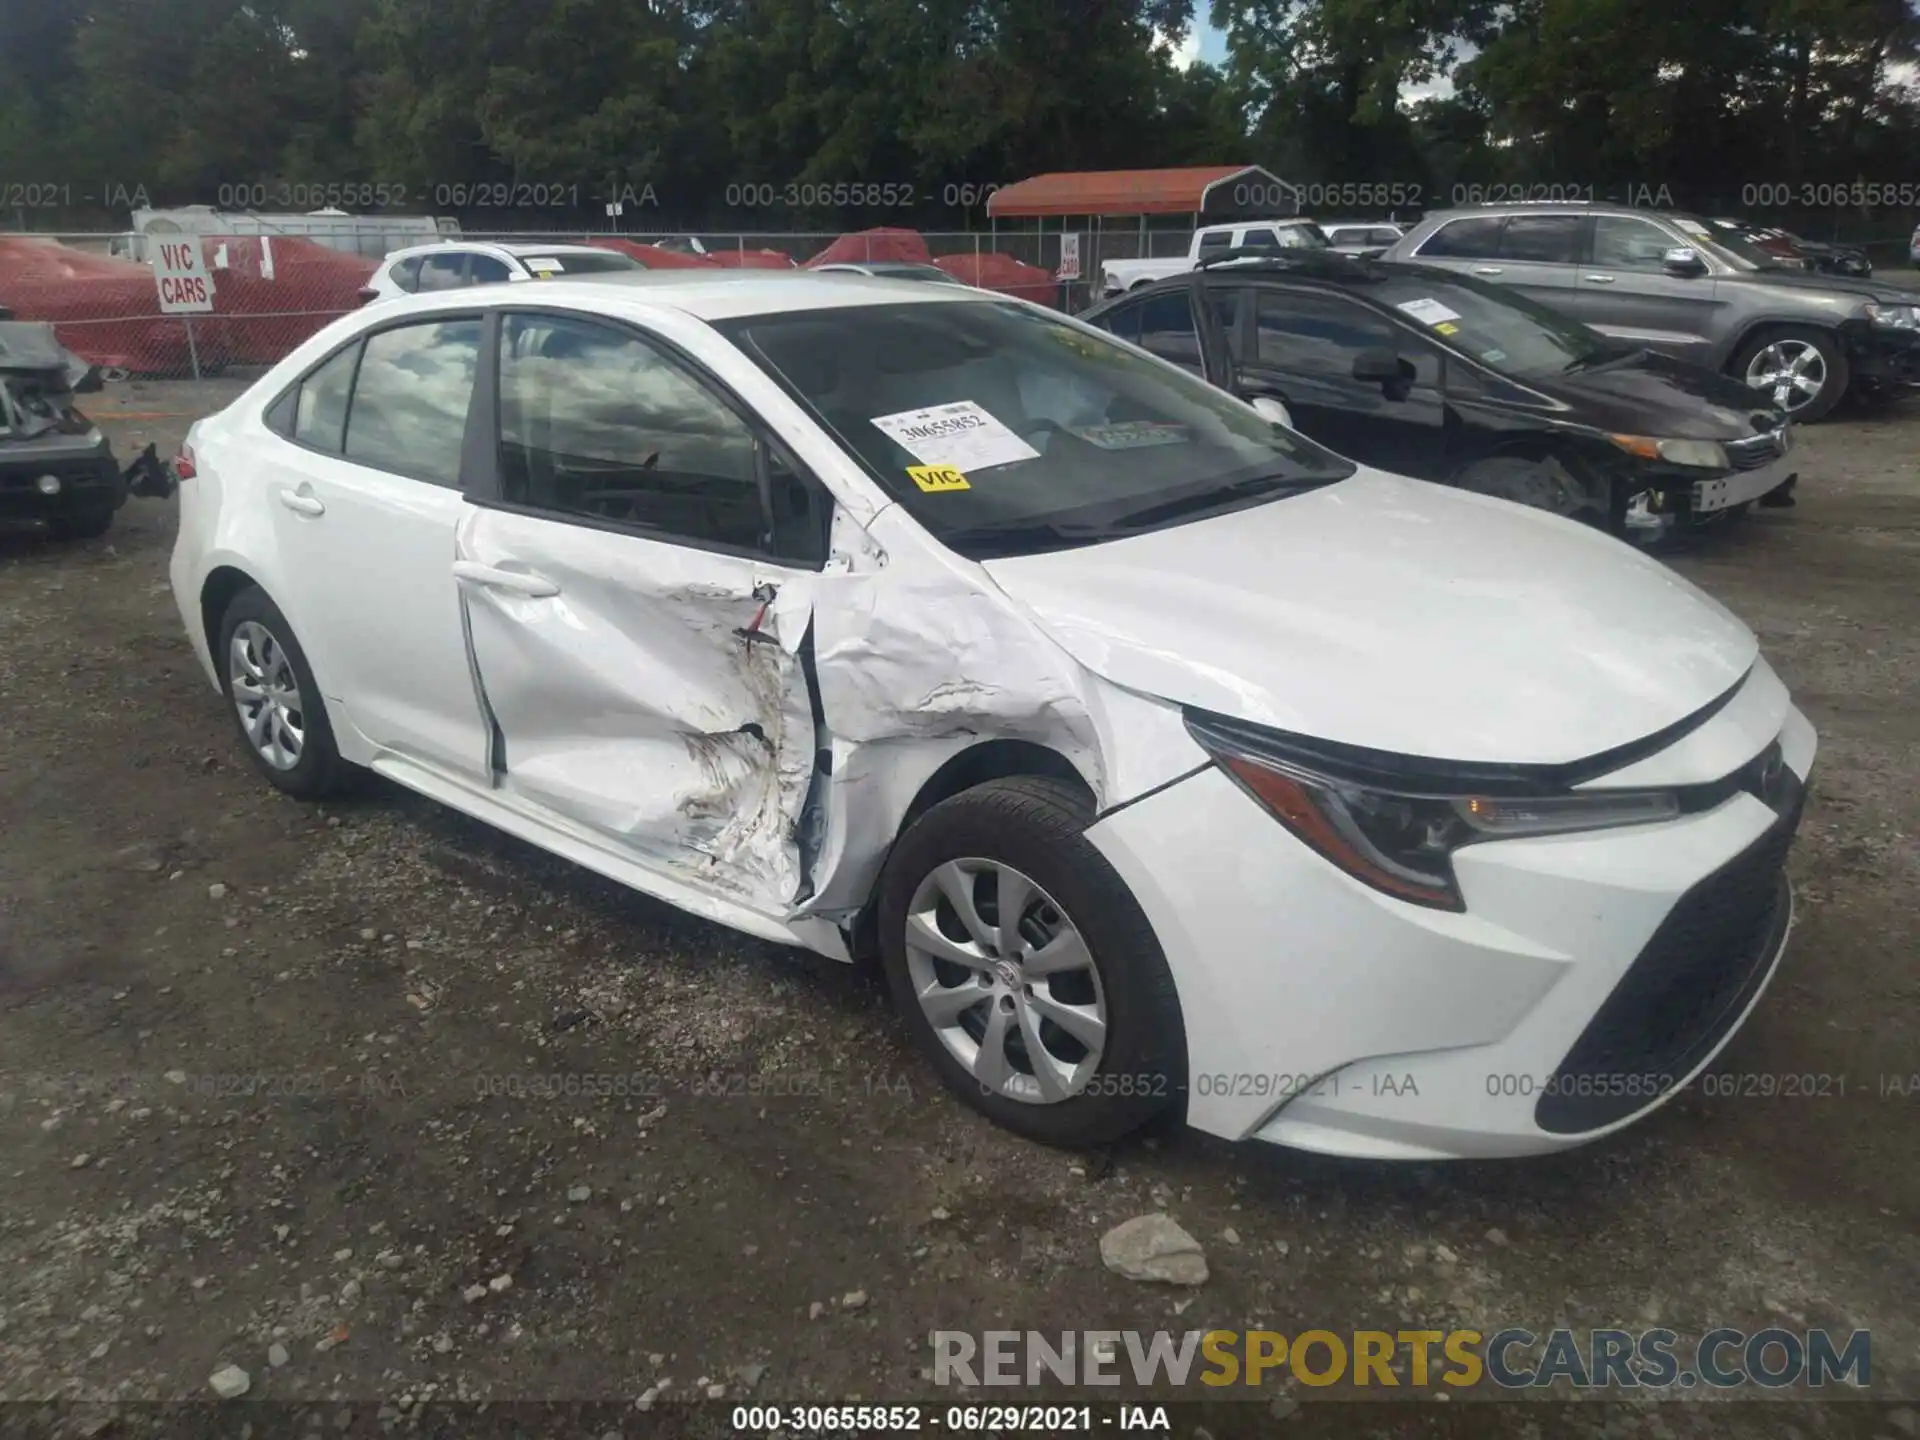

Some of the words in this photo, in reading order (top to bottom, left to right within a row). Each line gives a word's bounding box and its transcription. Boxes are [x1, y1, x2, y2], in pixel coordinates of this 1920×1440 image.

[160, 243, 193, 270] VIC
[161, 277, 207, 304] CARS
[899, 414, 988, 441] 30655852
[916, 469, 961, 486] VIC
